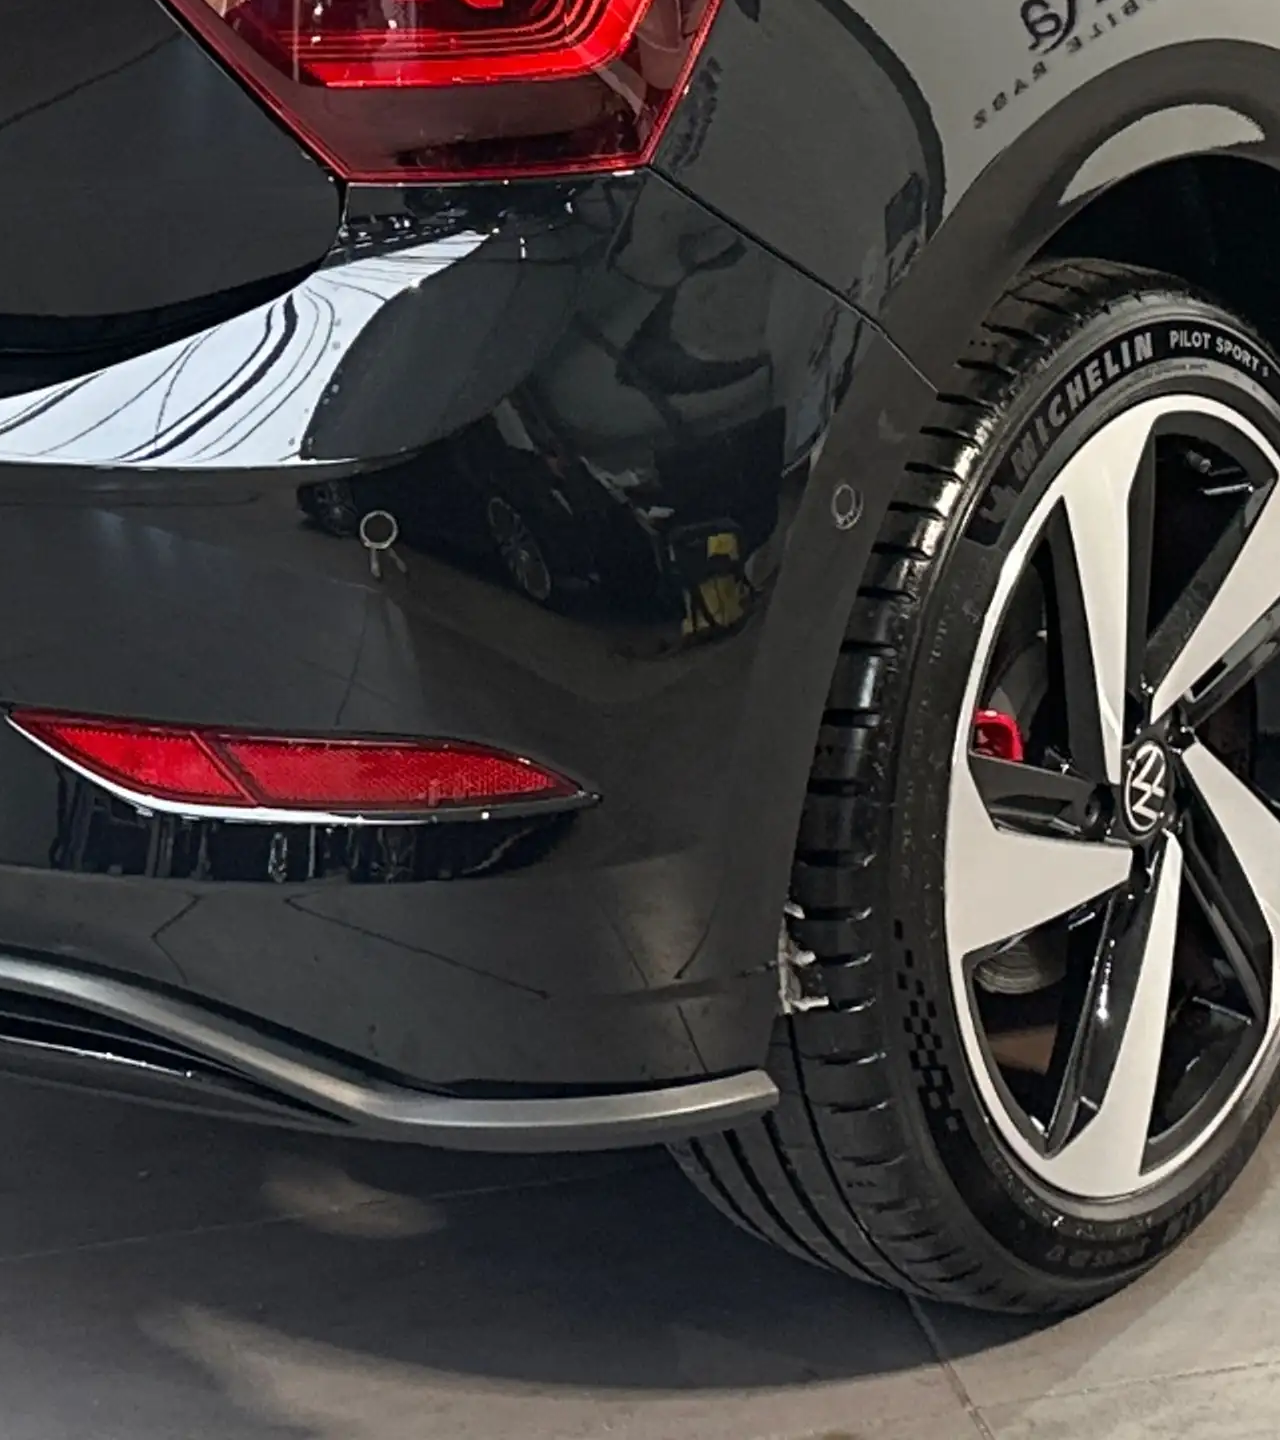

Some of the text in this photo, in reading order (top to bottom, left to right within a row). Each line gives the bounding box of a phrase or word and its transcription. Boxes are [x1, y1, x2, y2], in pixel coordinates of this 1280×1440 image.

[1011, 330, 1259, 481] MICHELIN PILOT SPORT
